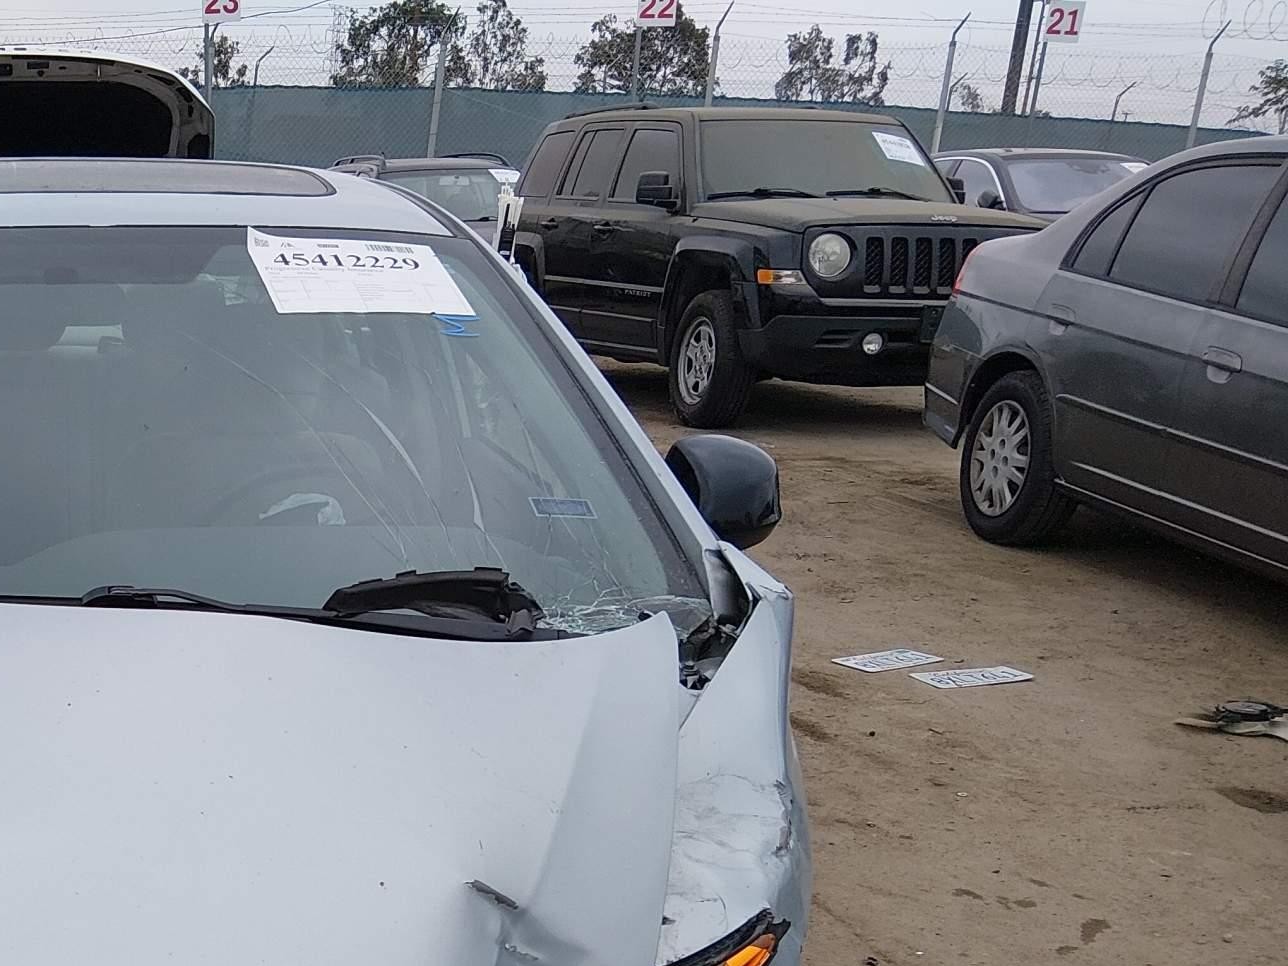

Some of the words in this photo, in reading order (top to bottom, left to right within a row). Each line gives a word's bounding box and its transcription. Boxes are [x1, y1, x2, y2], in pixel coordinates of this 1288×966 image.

[639, 0, 675, 19] 22
[1046, 7, 1079, 36] 21
[273, 252, 420, 271] 45412229
